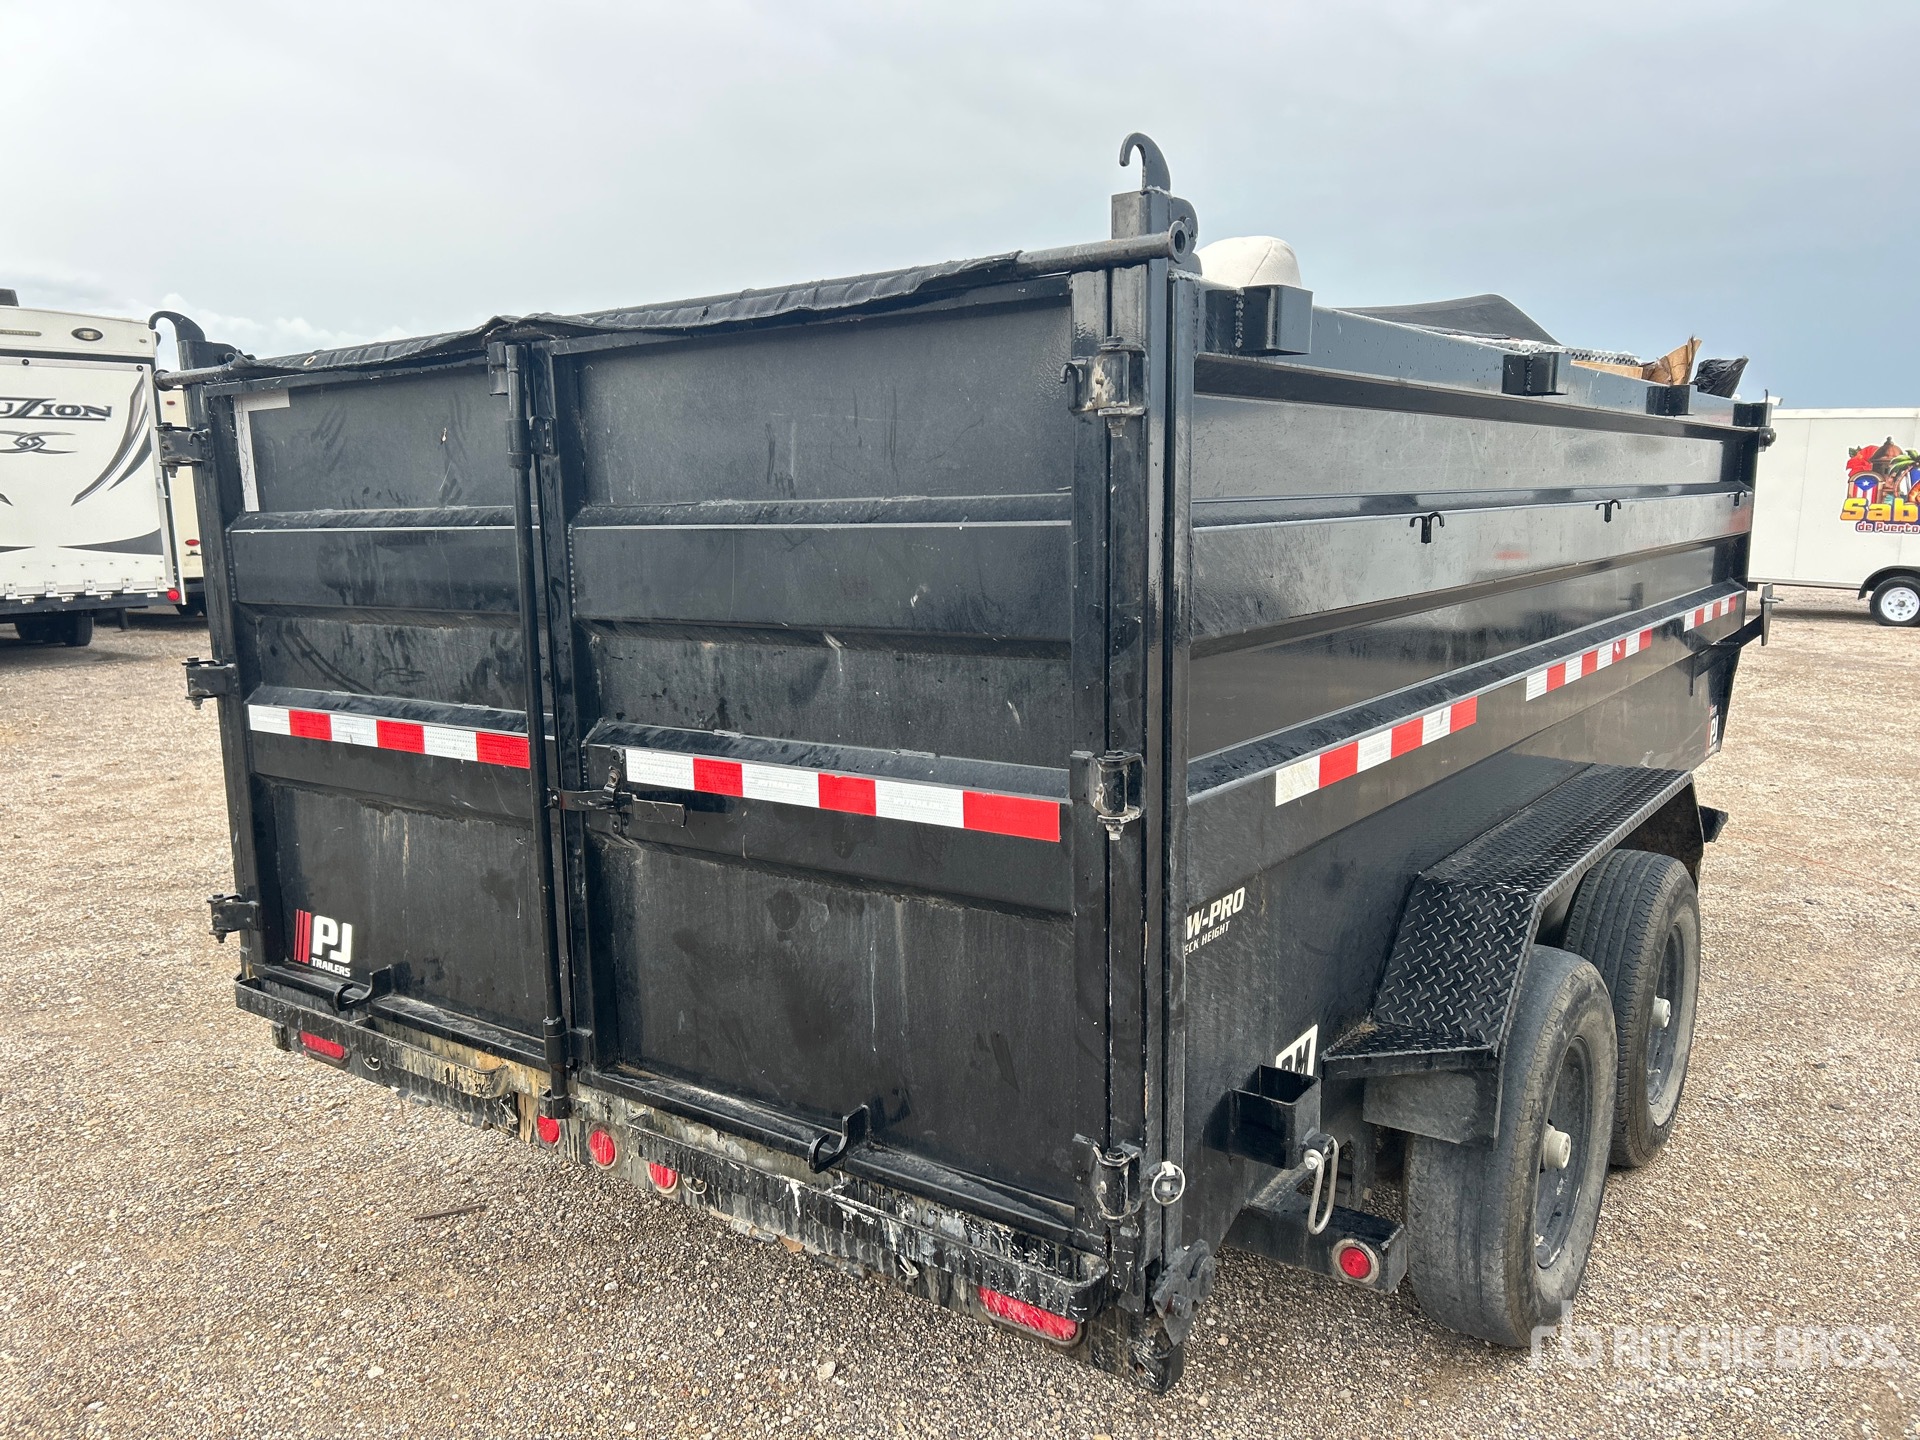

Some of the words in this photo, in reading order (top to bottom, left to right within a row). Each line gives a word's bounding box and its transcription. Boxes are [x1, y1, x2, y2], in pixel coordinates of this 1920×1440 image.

[1841, 497, 1919, 522] Sab
[1857, 522, 1873, 532] de
[1876, 522, 1919, 533] Puerto
[1186, 887, 1246, 941] W-PRO
[312, 915, 353, 964] PJ
[1201, 920, 1230, 946] HEIGHT
[311, 957, 351, 978] TRAILERS
